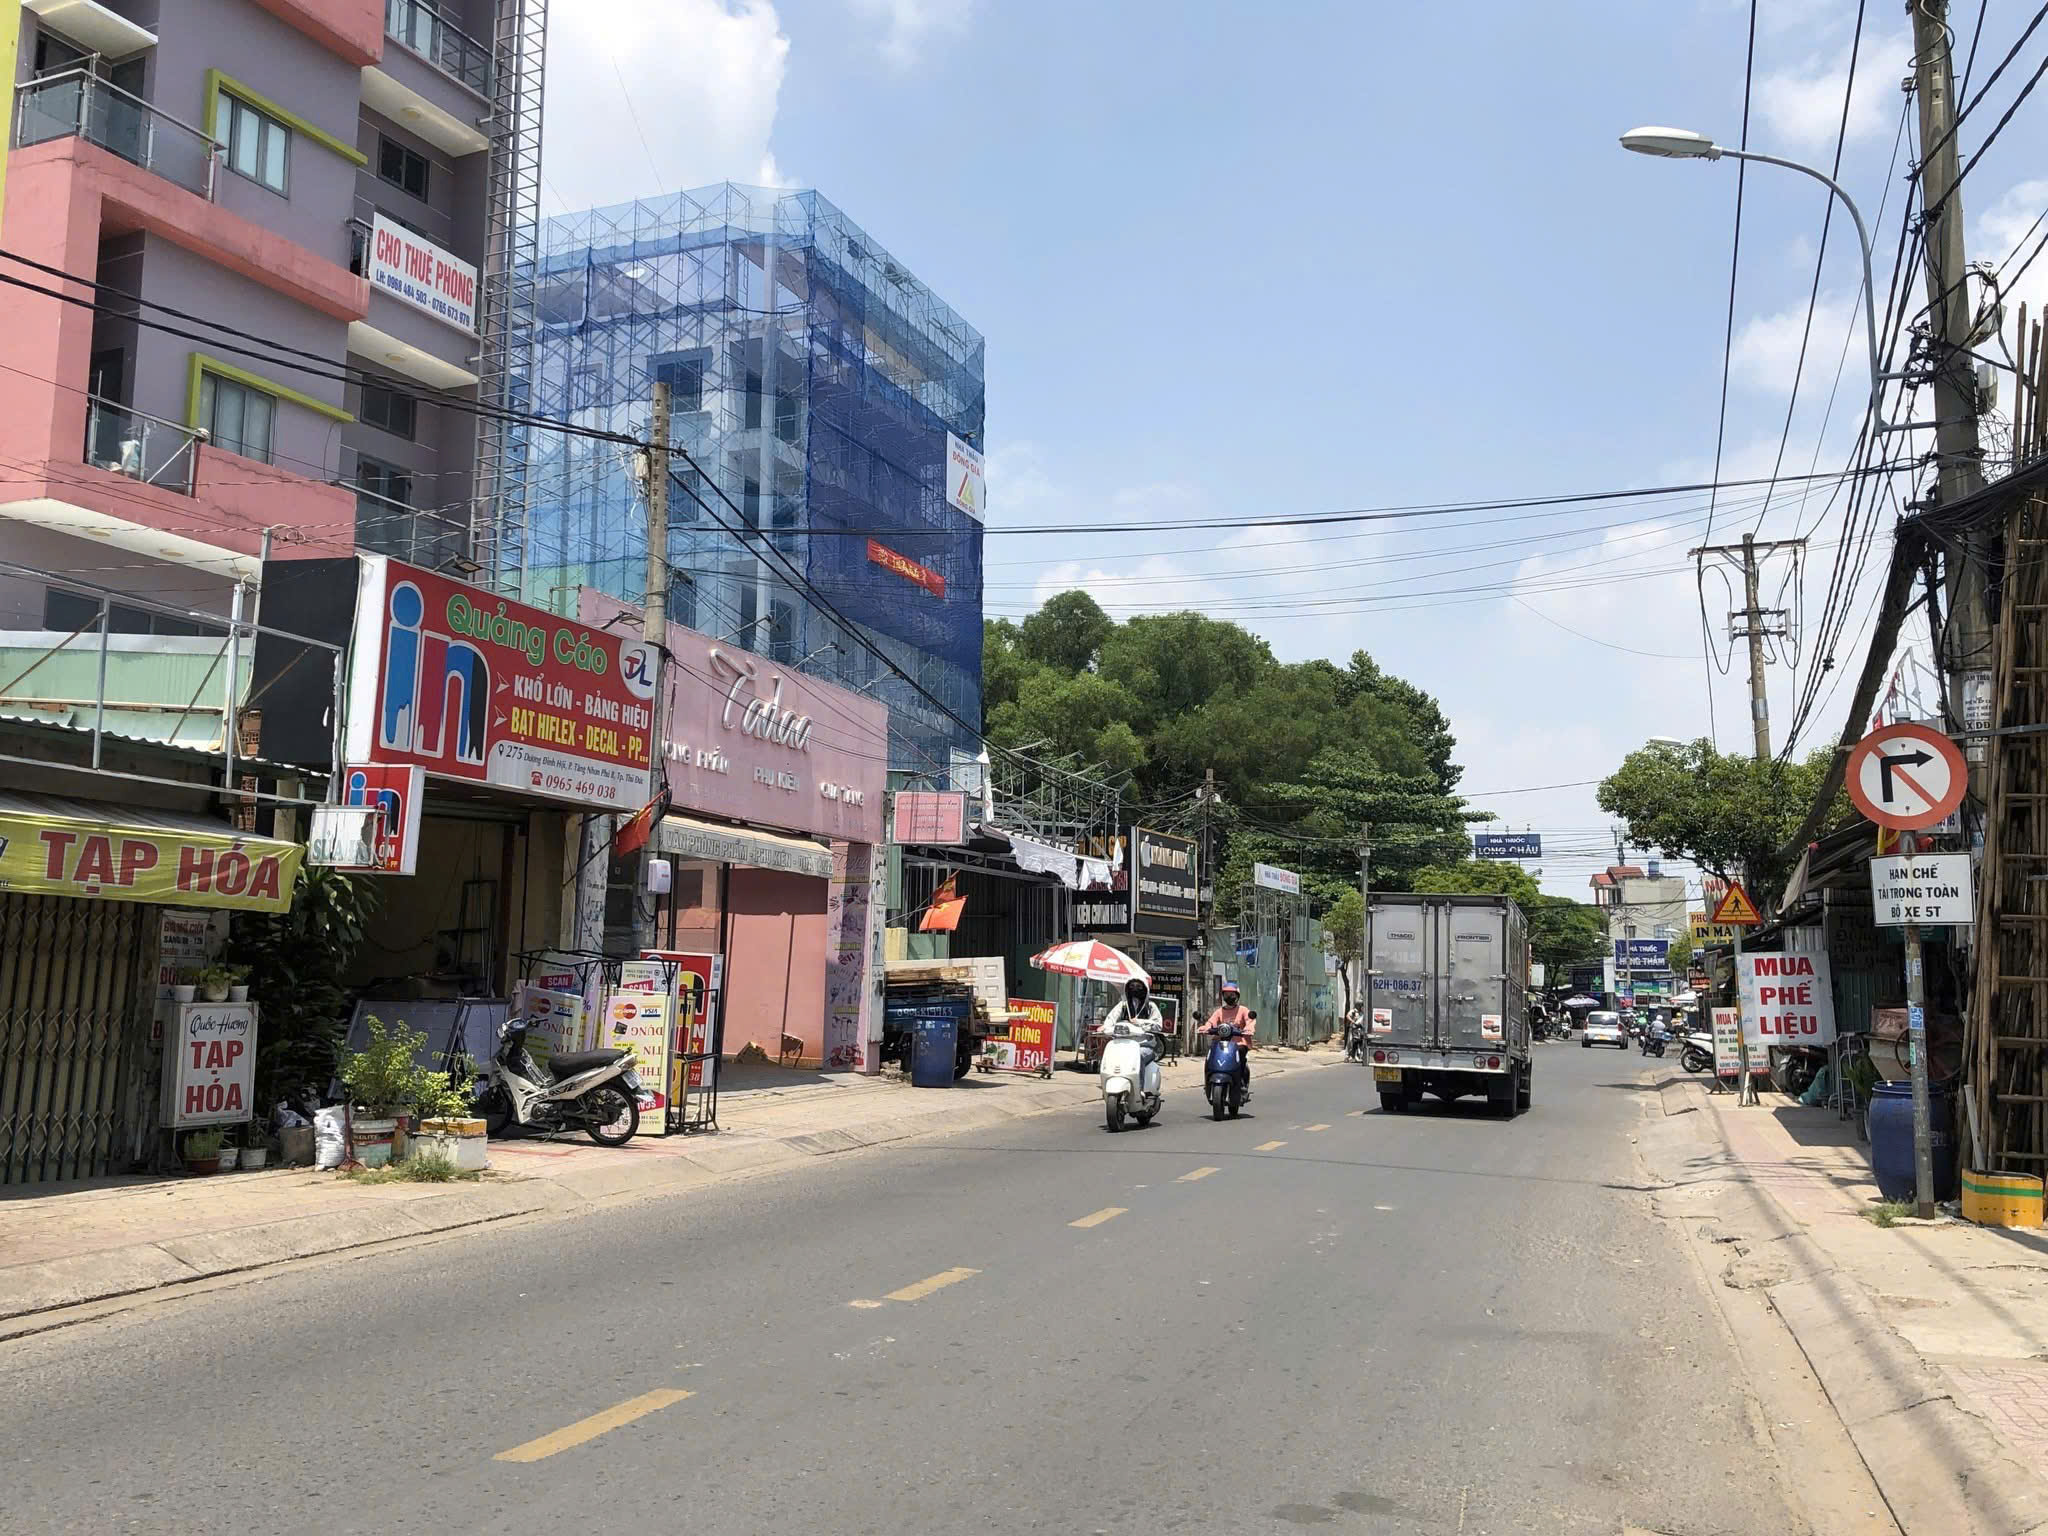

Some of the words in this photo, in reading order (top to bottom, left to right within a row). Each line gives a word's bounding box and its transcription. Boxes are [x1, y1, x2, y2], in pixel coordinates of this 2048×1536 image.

[376, 229, 401, 269] CHO
[405, 242, 433, 286] THUÊ
[435, 260, 473, 307] PHÒNG
[447, 594, 546, 666] Quảng
[553, 628, 608, 675] Cáo
[513, 672, 543, 702] KHỔ
[546, 681, 573, 710] LỚN
[584, 690, 619, 722] BẢNG
[622, 701, 649, 733] HIỆU
[511, 707, 535, 741] BẠT
[537, 713, 577, 747] HIFLEX
[585, 725, 619, 757] DECAL
[506, 744, 523, 760] 275
[546, 774, 572, 792] 0965
[575, 780, 594, 796] 469
[597, 785, 616, 799] 038
[1478, 846, 1506, 855] LONG
[1509, 844, 1538, 855] CHÂU
[40, 830, 158, 895] TẠP
[176, 843, 281, 900] HÓA
[1889, 868, 1908, 882] HẠN
[1912, 863, 1940, 879] CHẾ
[1878, 884, 1889, 900] TẢI
[1890, 887, 1922, 902] TRỌNG
[1925, 883, 1959, 898] TOÀN
[1891, 904, 1900, 921] BỘ
[1905, 906, 1921, 918] XE
[1925, 906, 1941, 918] 5T
[1696, 926, 1710, 938] IN
[1754, 957, 1814, 977] MUA
[547, 976, 569, 987] SCAN
[1760, 980, 1813, 1005] PHẾ
[190, 1014, 216, 1038] Quốc
[214, 1013, 249, 1036] Hương
[1760, 1012, 1817, 1039] LIỆU
[190, 1040, 244, 1075] TẠP
[185, 1077, 243, 1114] HÓA
